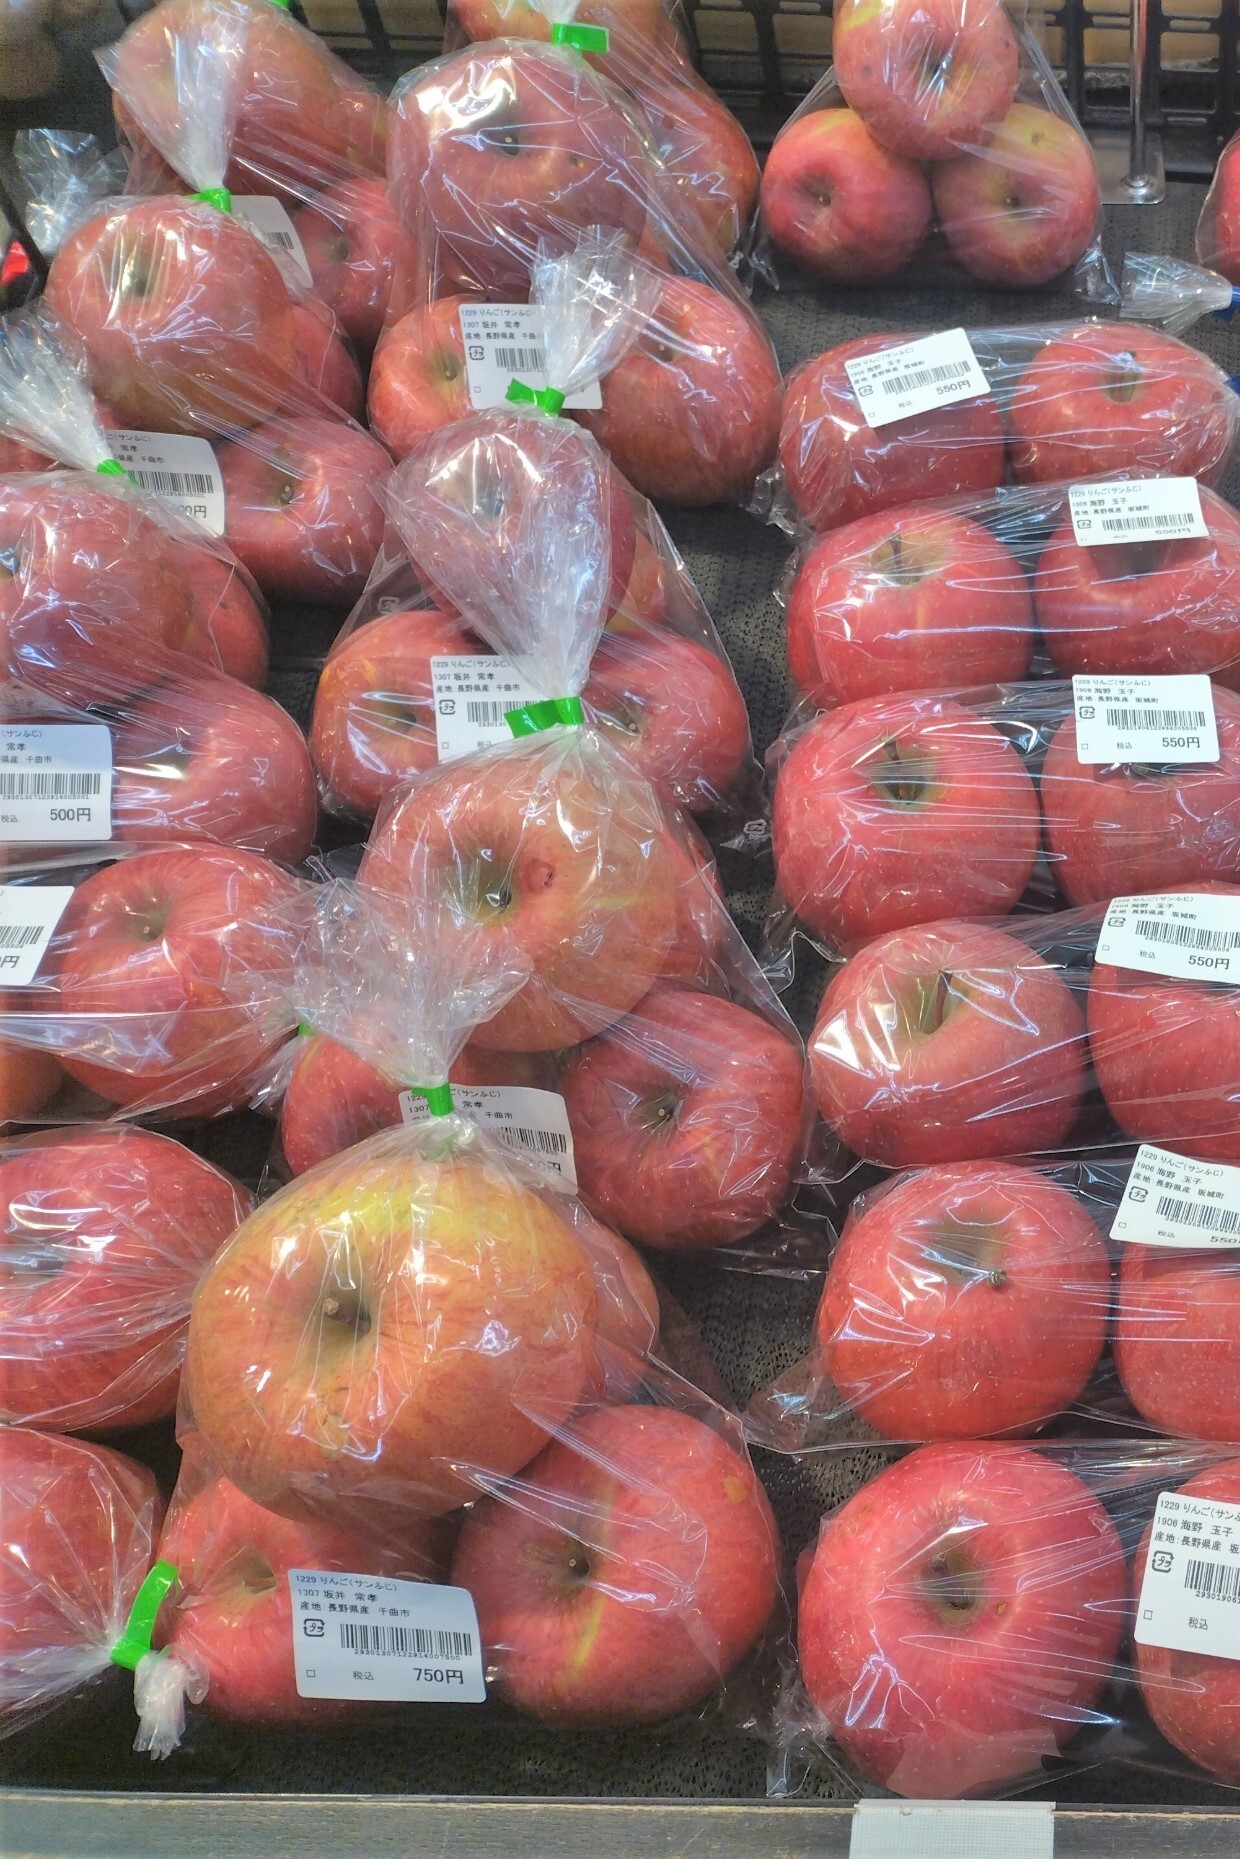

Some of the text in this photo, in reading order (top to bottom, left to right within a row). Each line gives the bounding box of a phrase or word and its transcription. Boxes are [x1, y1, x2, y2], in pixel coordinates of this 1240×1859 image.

[461, 308, 478, 317] 1229
[504, 320, 521, 329] 常孝
[887, 357, 902, 366] 玉子
[897, 379, 972, 409] 税込 550円
[1112, 497, 1128, 506] 玉子
[432, 660, 449, 669] 1229
[434, 672, 451, 681] 1307
[477, 672, 495, 681] 常孝
[495, 683, 520, 692] 千曲市
[1092, 678, 1151, 687] りんご(サンふじ)
[1094, 686, 1135, 695] 海野 玉子
[5, 742, 26, 752] 常孝
[1116, 736, 1201, 750] 税込 550円
[25, 754, 52, 764] 千曲市
[0, 807, 92, 824] 税込 500円
[1156, 901, 1174, 909] 玉子
[1139, 950, 1230, 970] 税込 550円
[462, 1100, 484, 1109] 常孝
[484, 1110, 513, 1119] 千曲市
[1140, 1149, 1224, 1177] 1229 りんご(サンふじ)
[1155, 1167, 1176, 1180] 海野
[1182, 1175, 1202, 1185] 玉子
[1157, 1229, 1175, 1239] 税込
[1160, 1499, 1180, 1511] 1229
[1157, 1516, 1234, 1538] 1906 海野 玉子
[1153, 1530, 1222, 1552] 産地:長野県産
[295, 1575, 398, 1592] 1229 りんご(サンふじ)
[297, 1588, 377, 1603] 1307 坂井 常孝
[378, 1607, 410, 1618] 千曲市
[1187, 1616, 1209, 1631] 税込
[352, 1667, 464, 1685] 税込 750円
